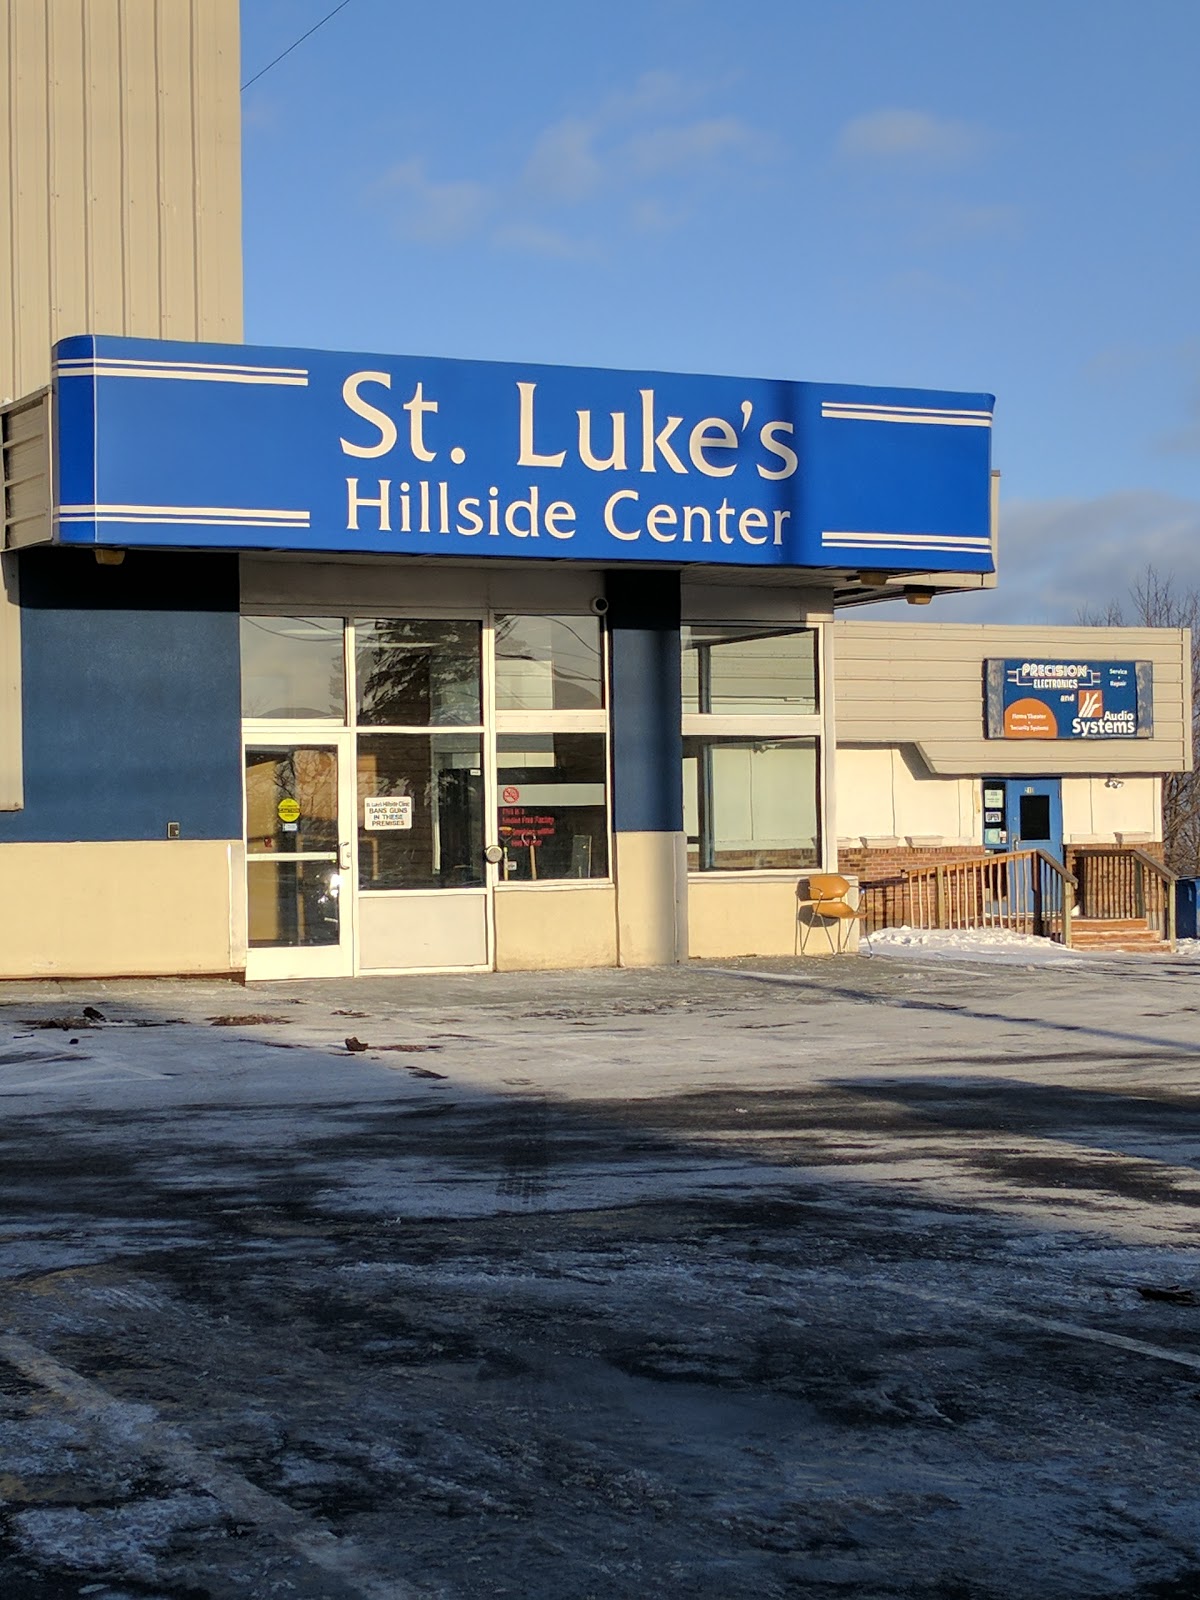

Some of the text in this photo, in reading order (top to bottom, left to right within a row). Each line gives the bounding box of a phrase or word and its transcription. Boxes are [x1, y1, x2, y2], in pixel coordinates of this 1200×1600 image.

[339, 370, 798, 481] St. Luke's
[345, 477, 791, 545] Hillside Center
[1021, 663, 1088, 678] PRECISION
[1033, 679, 1078, 689] ELECTRONICS
[1060, 694, 1075, 702] and
[1104, 711, 1134, 721] Audio
[1072, 718, 1135, 736] Systems
